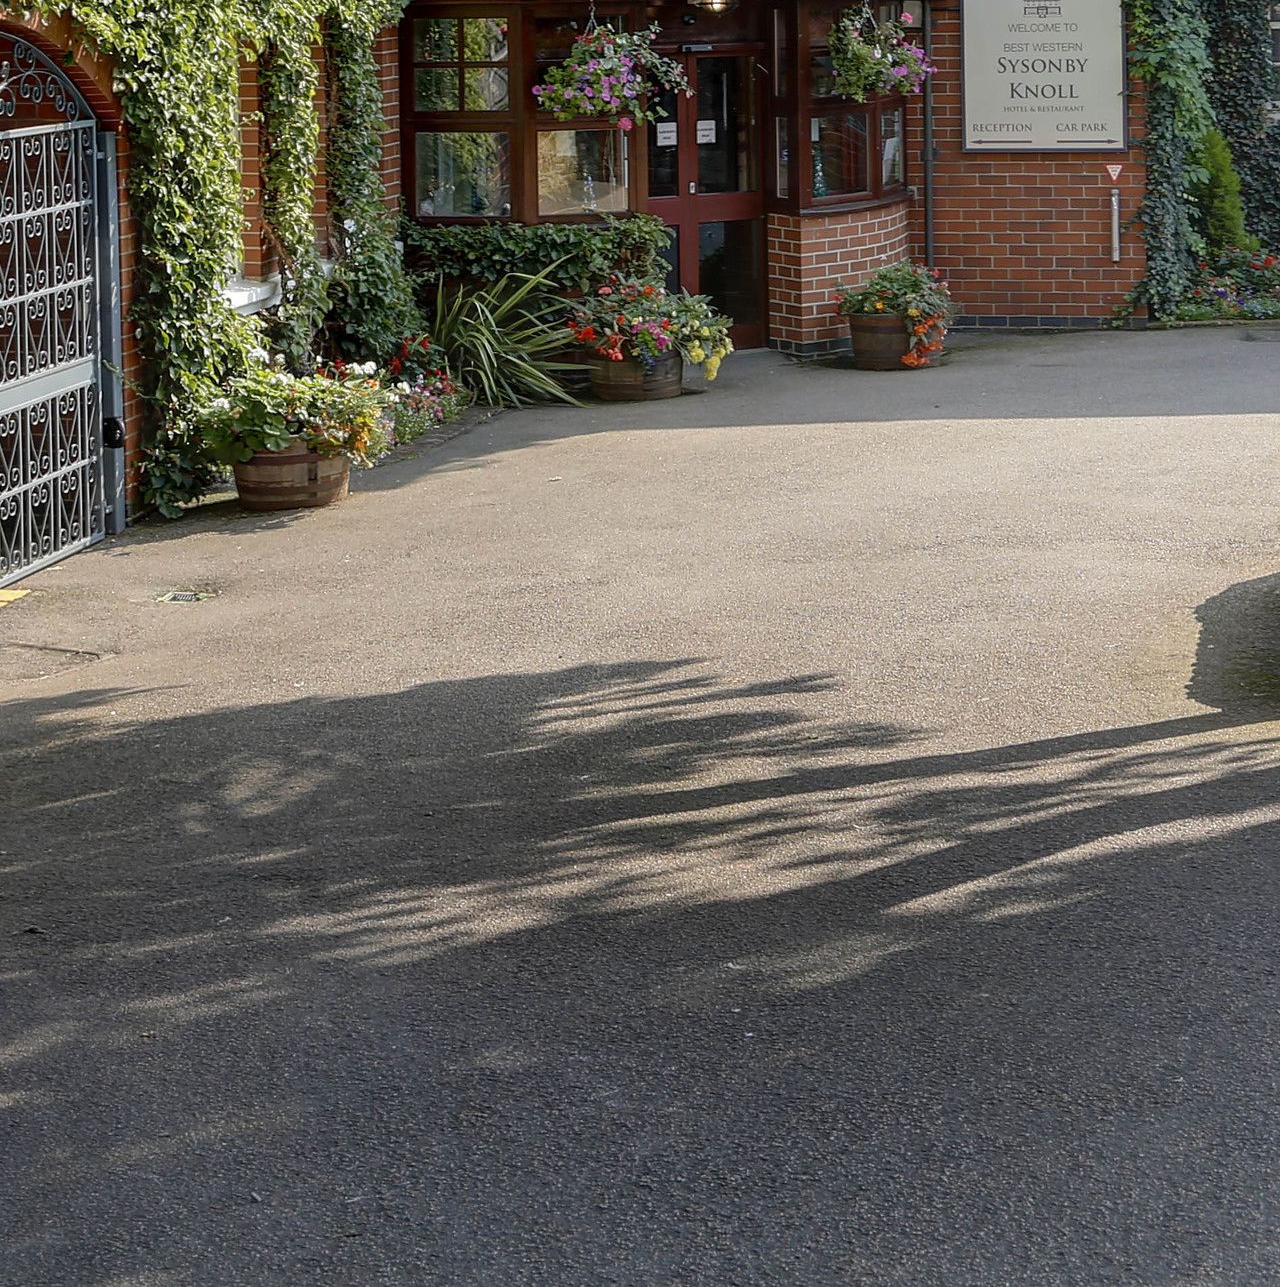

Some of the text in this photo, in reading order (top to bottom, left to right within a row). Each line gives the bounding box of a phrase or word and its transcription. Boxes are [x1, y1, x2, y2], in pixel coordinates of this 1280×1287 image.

[1008, 22, 1078, 33] WELCOME TO
[1003, 42, 1083, 53] BEST WESTERN
[1037, 105, 1084, 113] RESTAURANT
[972, 123, 1032, 132] RECEPTION
[1056, 122, 1108, 132] CAR PARK
